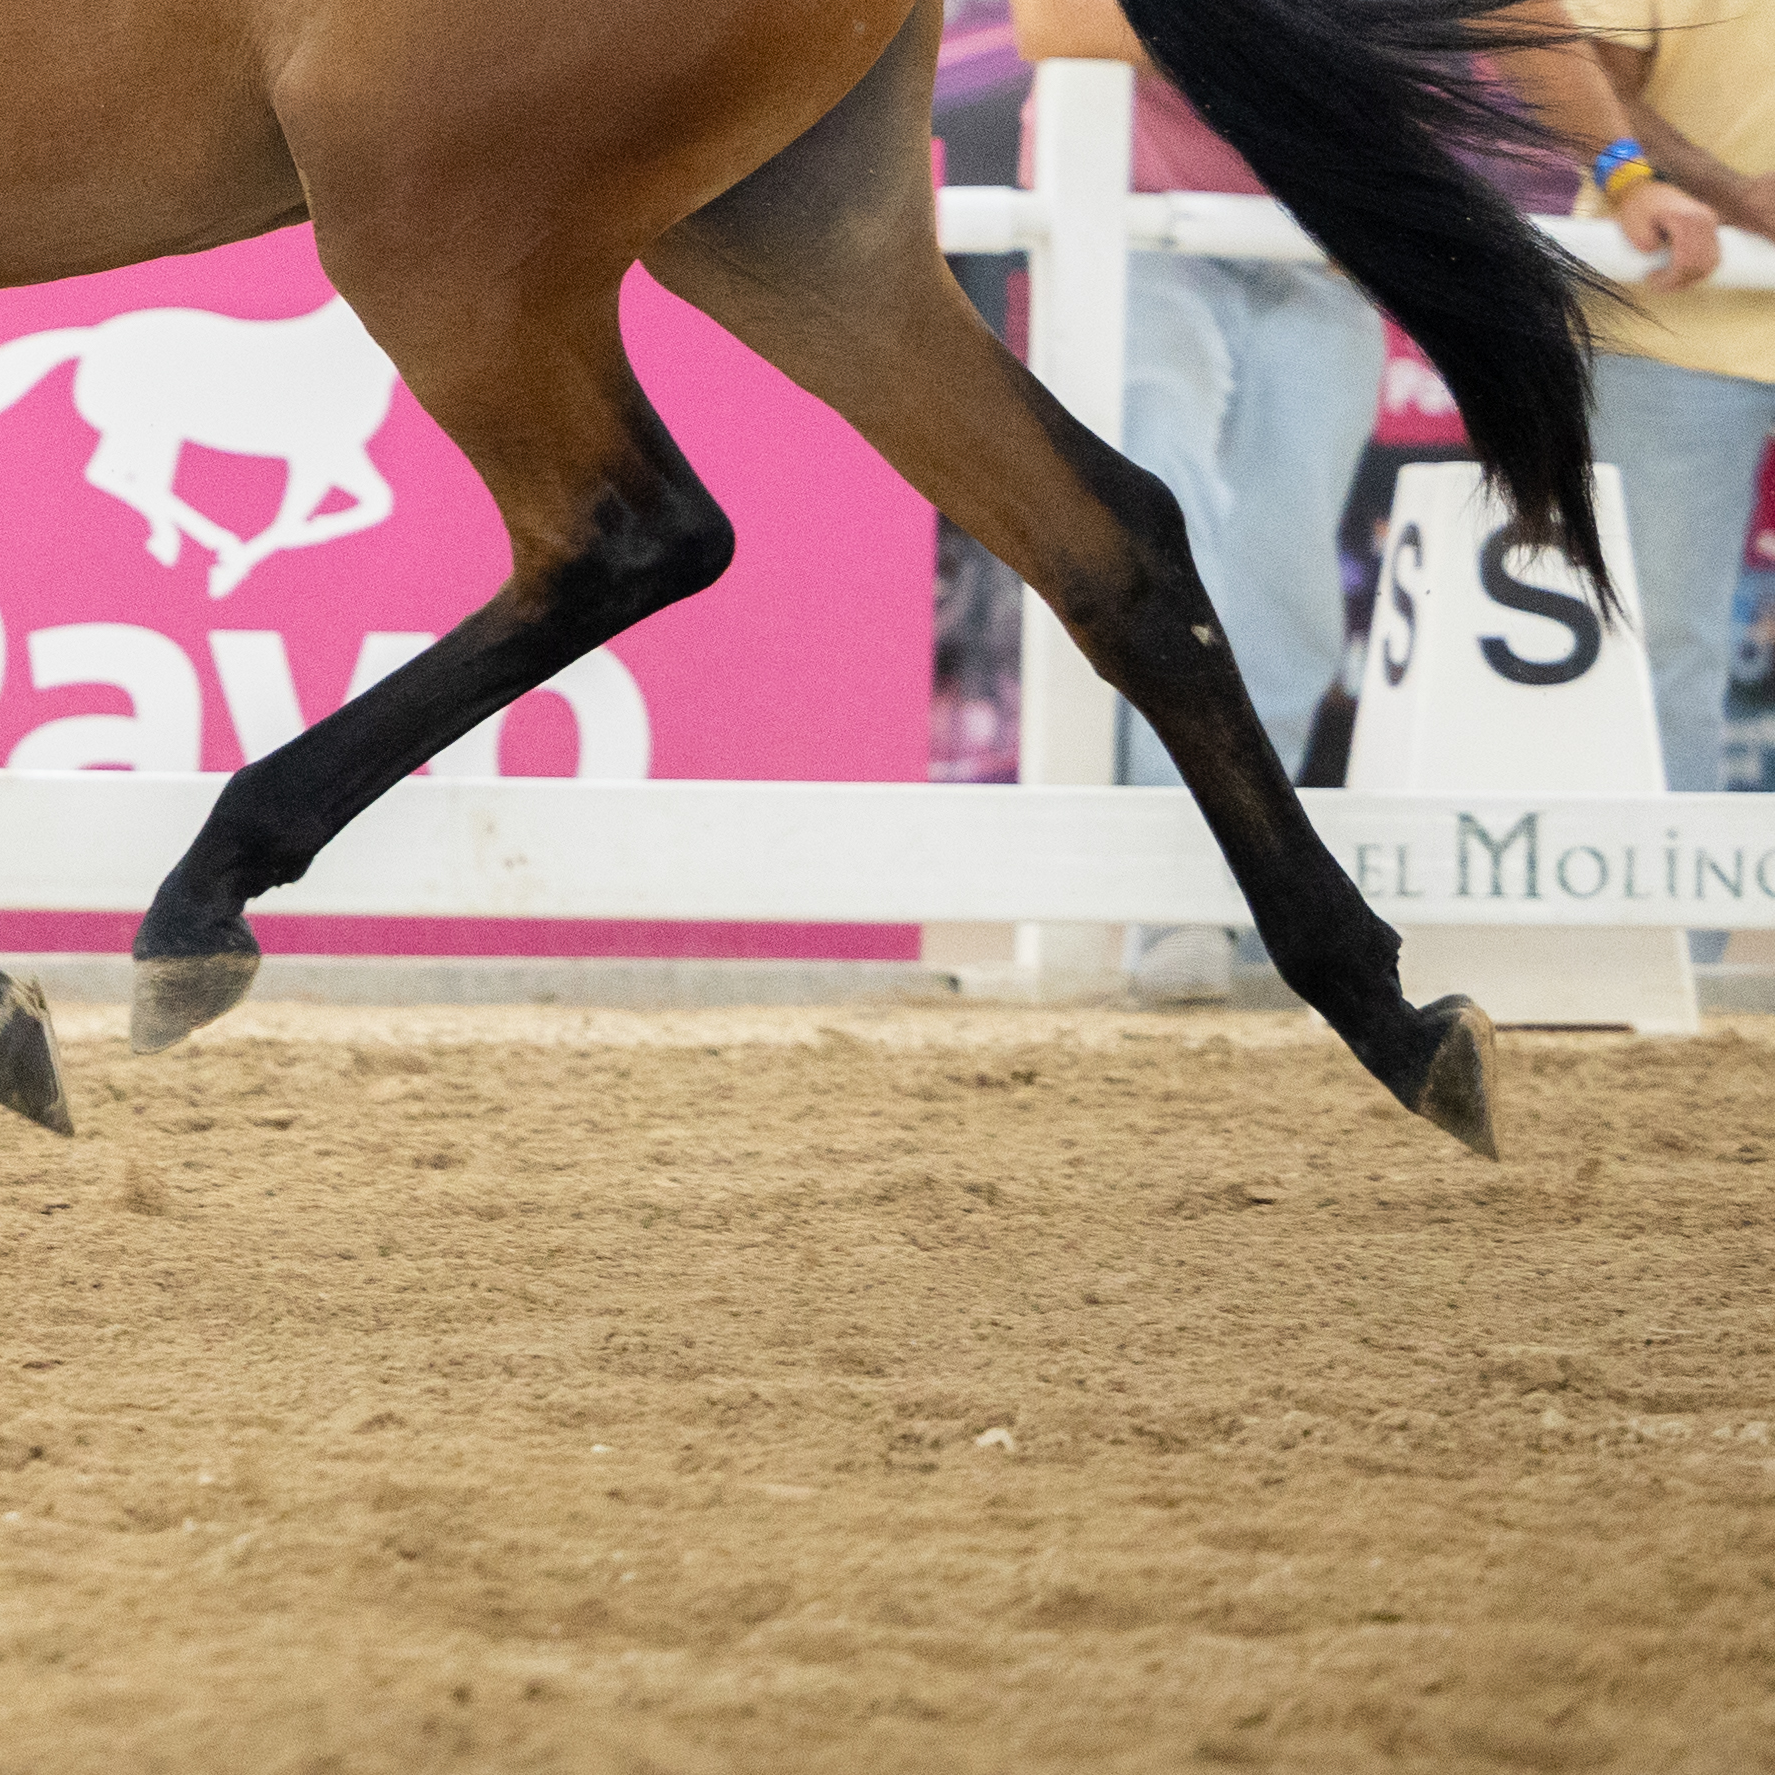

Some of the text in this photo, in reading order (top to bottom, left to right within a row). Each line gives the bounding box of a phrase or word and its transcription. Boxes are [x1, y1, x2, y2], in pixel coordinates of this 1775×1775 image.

[1382, 521, 1425, 687] S
[1479, 521, 1602, 687] S
[1355, 843, 1429, 901] EL
